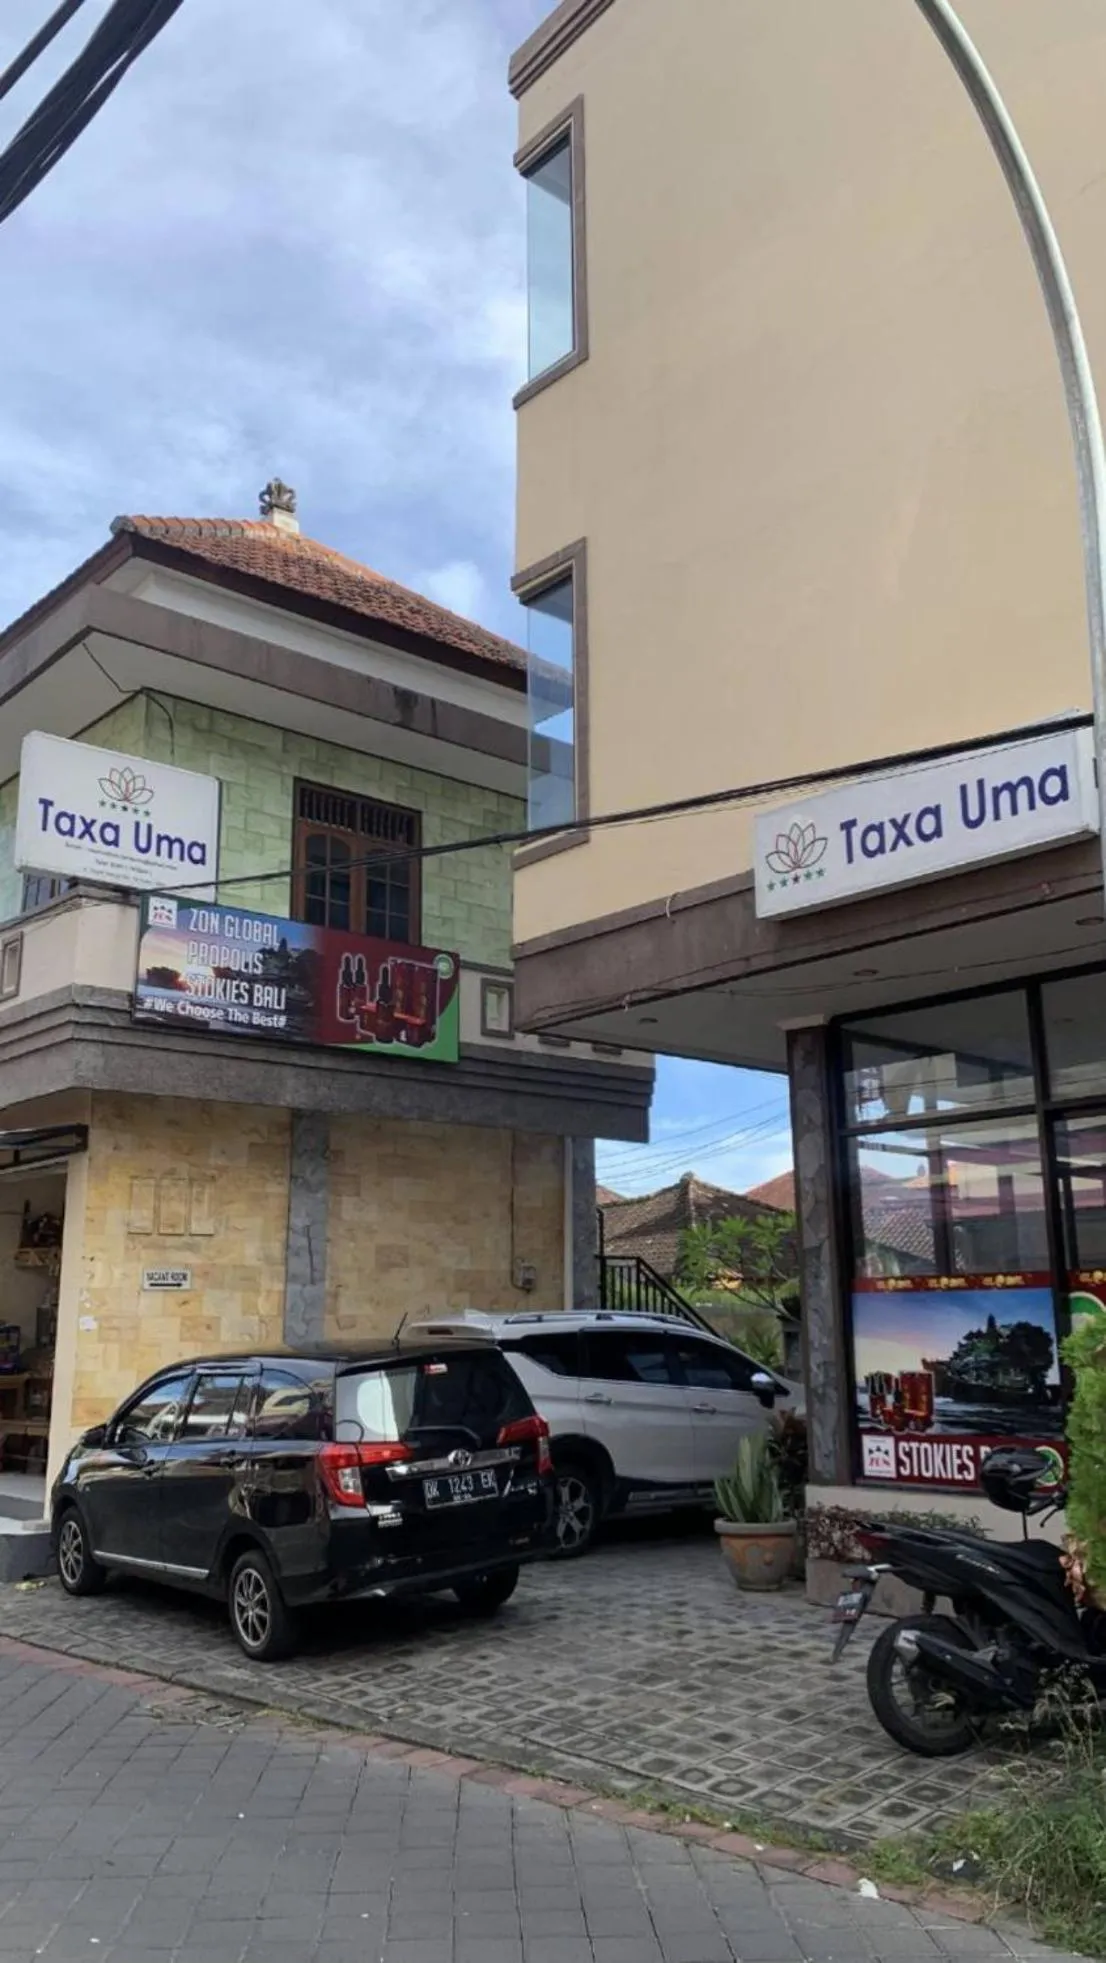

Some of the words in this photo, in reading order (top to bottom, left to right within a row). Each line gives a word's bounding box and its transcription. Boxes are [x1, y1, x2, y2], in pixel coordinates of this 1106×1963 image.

[37, 797, 121, 846] Taxa
[133, 819, 207, 866] Uma
[840, 803, 942, 865] Taxa
[959, 763, 1071, 829] Uma
[189, 908, 220, 935] ZON
[224, 914, 280, 948] GLOBAL
[187, 941, 263, 974] PROPOLIS
[186, 974, 250, 1005] STOKIES
[253, 985, 286, 1010] BALI
[144, 997, 174, 1012] #We
[176, 1001, 225, 1020] Choose
[227, 1007, 250, 1023] The
[252, 1011, 287, 1028] Best#
[898, 1441, 976, 1481] STOKIES
[447, 1475, 474, 1493] 1243
